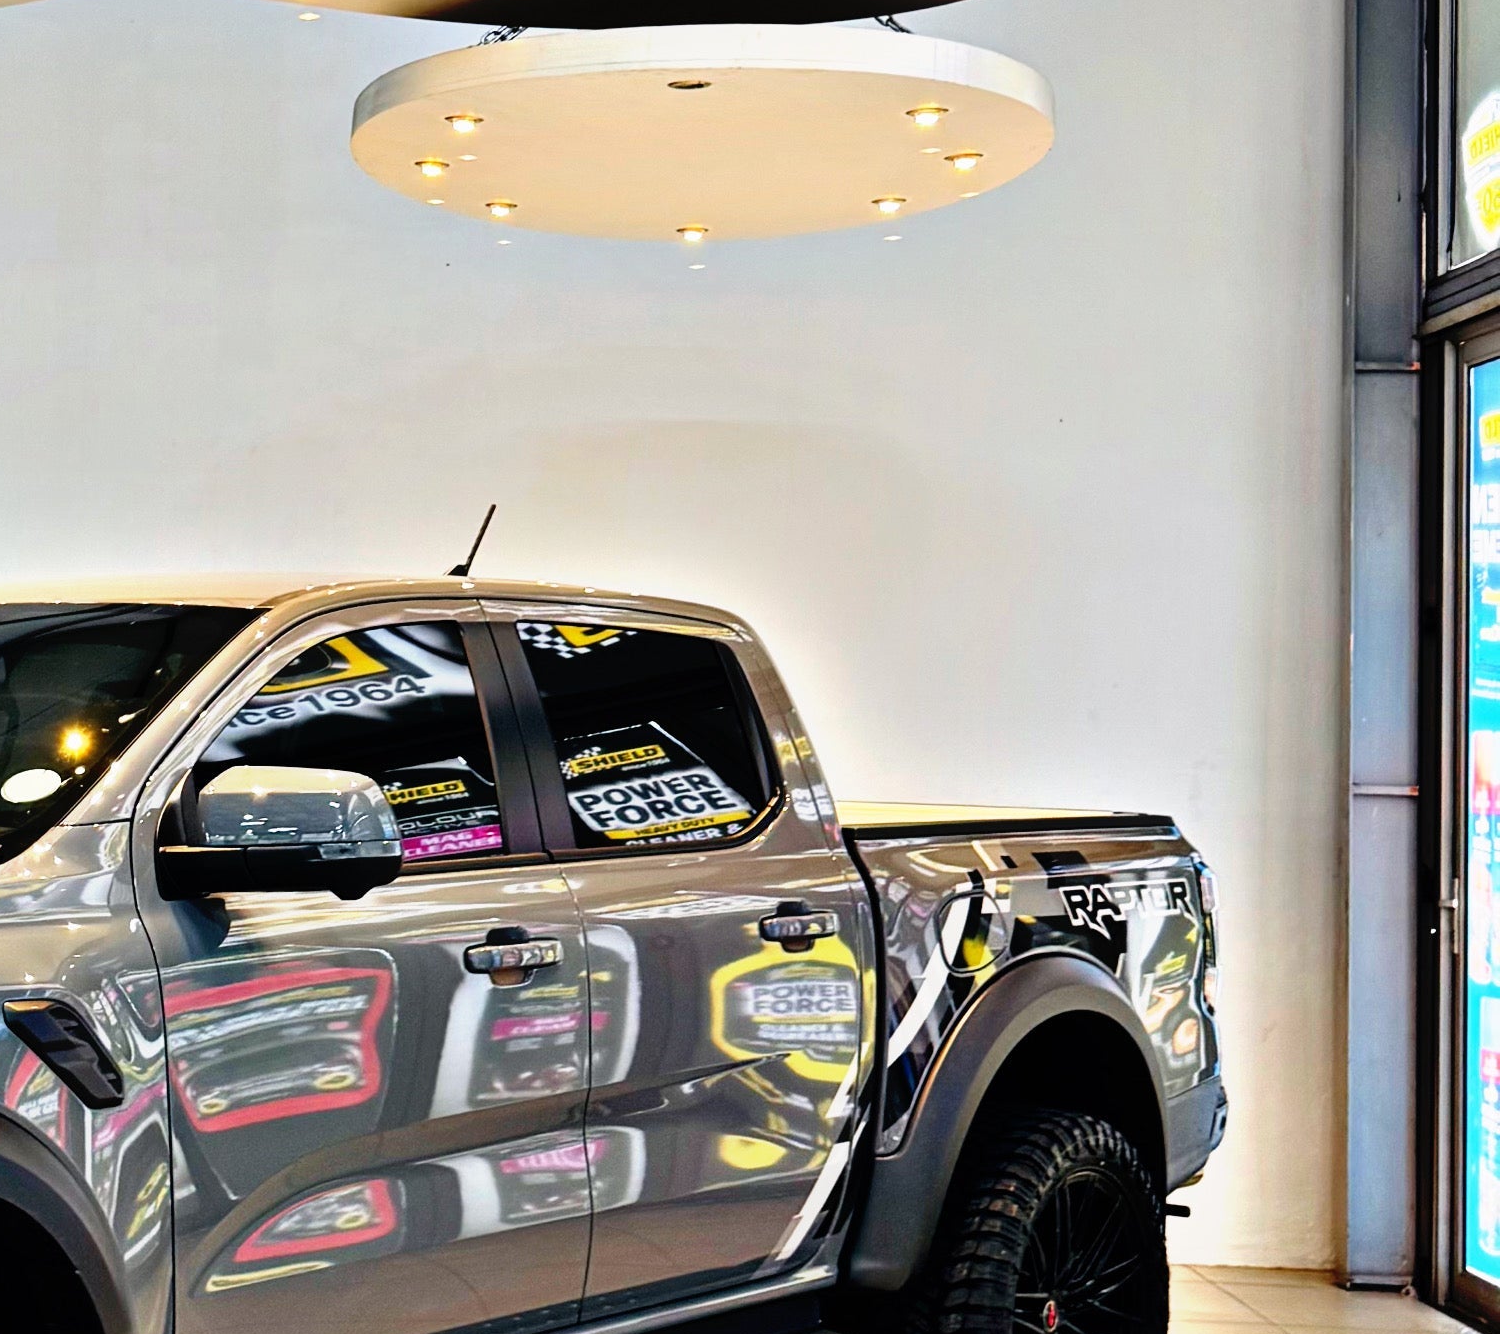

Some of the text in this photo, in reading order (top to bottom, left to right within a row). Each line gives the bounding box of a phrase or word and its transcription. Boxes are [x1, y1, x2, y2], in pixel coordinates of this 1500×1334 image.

[576, 748, 658, 769] SHIELD
[389, 782, 460, 801] HIELD
[575, 774, 717, 812] POWER
[588, 790, 736, 828] FORCE
[681, 817, 715, 828] DUTY
[1059, 878, 1194, 939] RAPTOR
[753, 984, 849, 999] POWER
[753, 998, 855, 1013] FORCE
